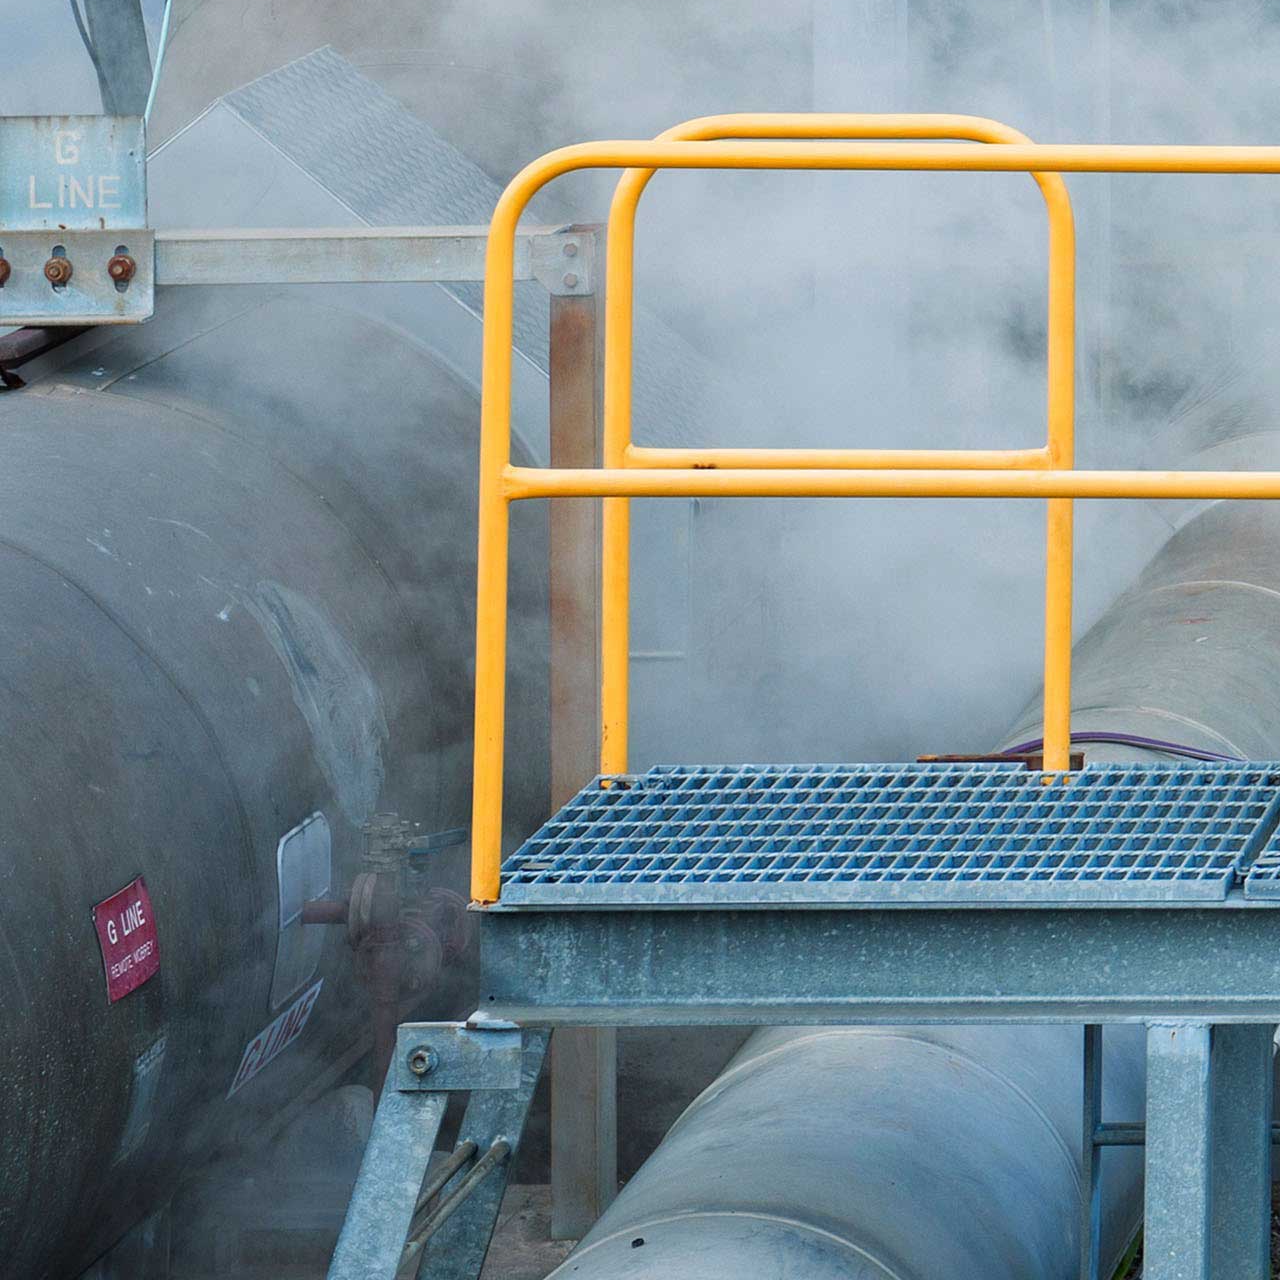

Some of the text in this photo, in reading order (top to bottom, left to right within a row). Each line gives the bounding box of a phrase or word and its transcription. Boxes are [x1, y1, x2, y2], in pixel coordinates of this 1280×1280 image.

[55, 130, 81, 165] G
[29, 175, 121, 208] LINE
[107, 900, 146, 944] G LINE
[110, 954, 134, 980] REMOTE
[255, 990, 316, 1070] LINE
